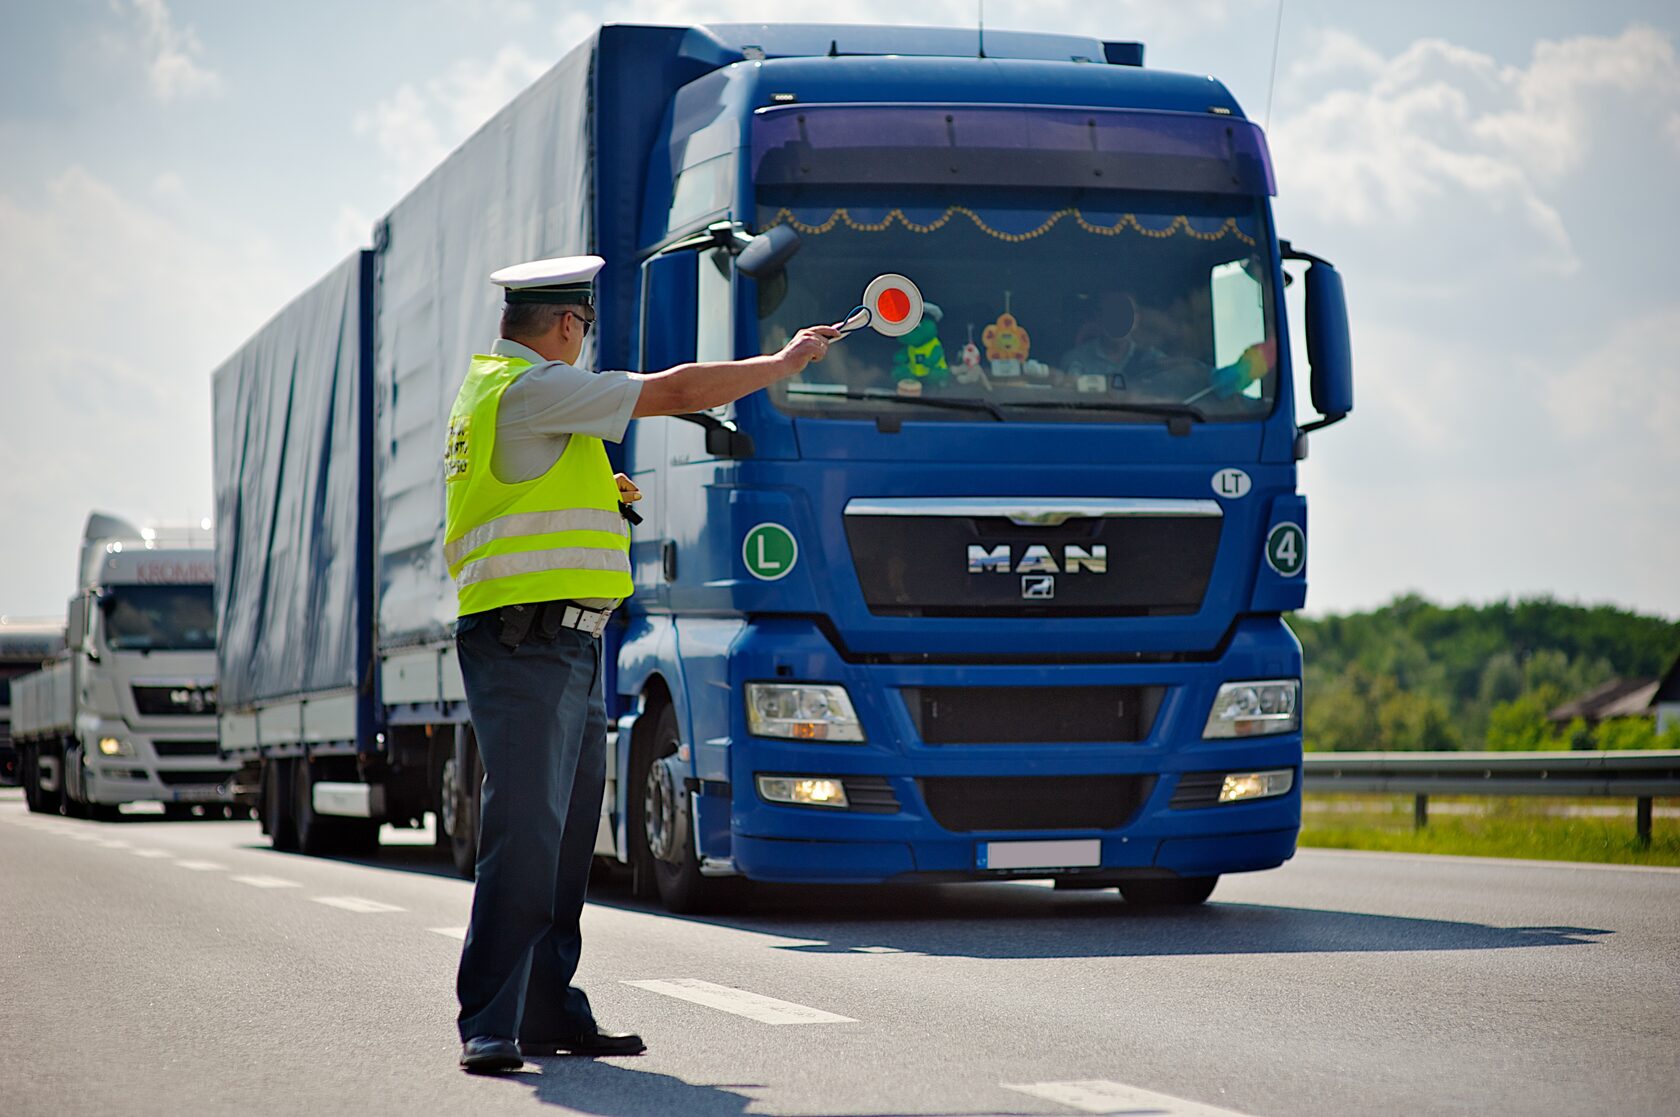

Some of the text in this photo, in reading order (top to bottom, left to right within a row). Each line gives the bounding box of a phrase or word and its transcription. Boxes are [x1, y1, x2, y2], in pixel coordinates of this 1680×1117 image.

[1222, 473, 1242, 493] LT
[757, 534, 781, 569] L
[967, 545, 1107, 573] MAN
[1276, 530, 1298, 567] 4
